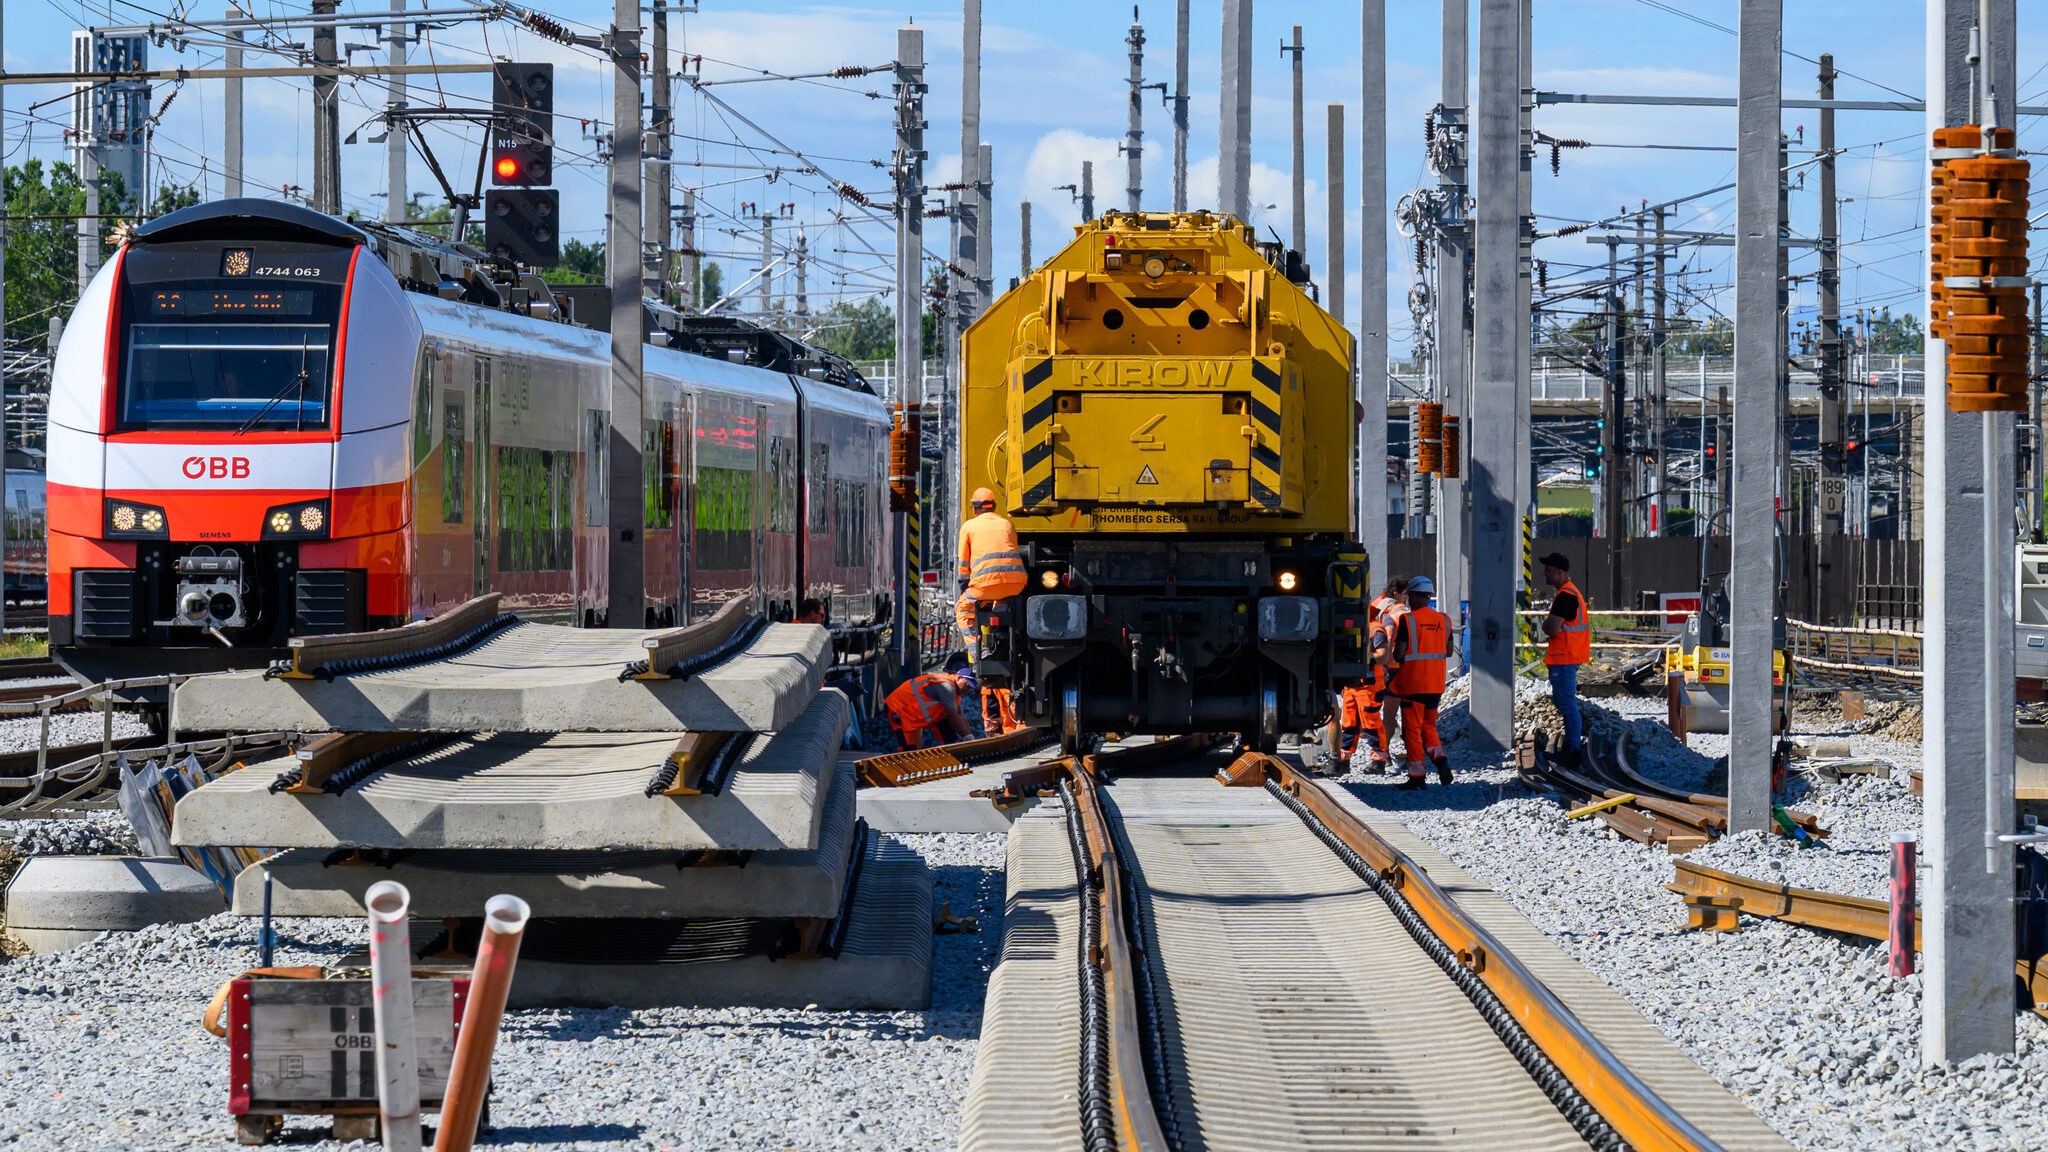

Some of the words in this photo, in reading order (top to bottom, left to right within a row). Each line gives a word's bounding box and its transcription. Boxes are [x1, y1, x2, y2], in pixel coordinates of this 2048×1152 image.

[498, 139, 517, 148] N15
[255, 267, 290, 276] 4744
[294, 268, 321, 277] 063
[1072, 359, 1234, 388] KIROW
[182, 456, 250, 479] ÖBB
[1821, 480, 1842, 494] 189
[1828, 497, 1836, 511] 0
[1092, 515, 1153, 524] RHOMBERG
[1156, 515, 1189, 524] SERSA
[335, 1034, 372, 1049] ÖBB
